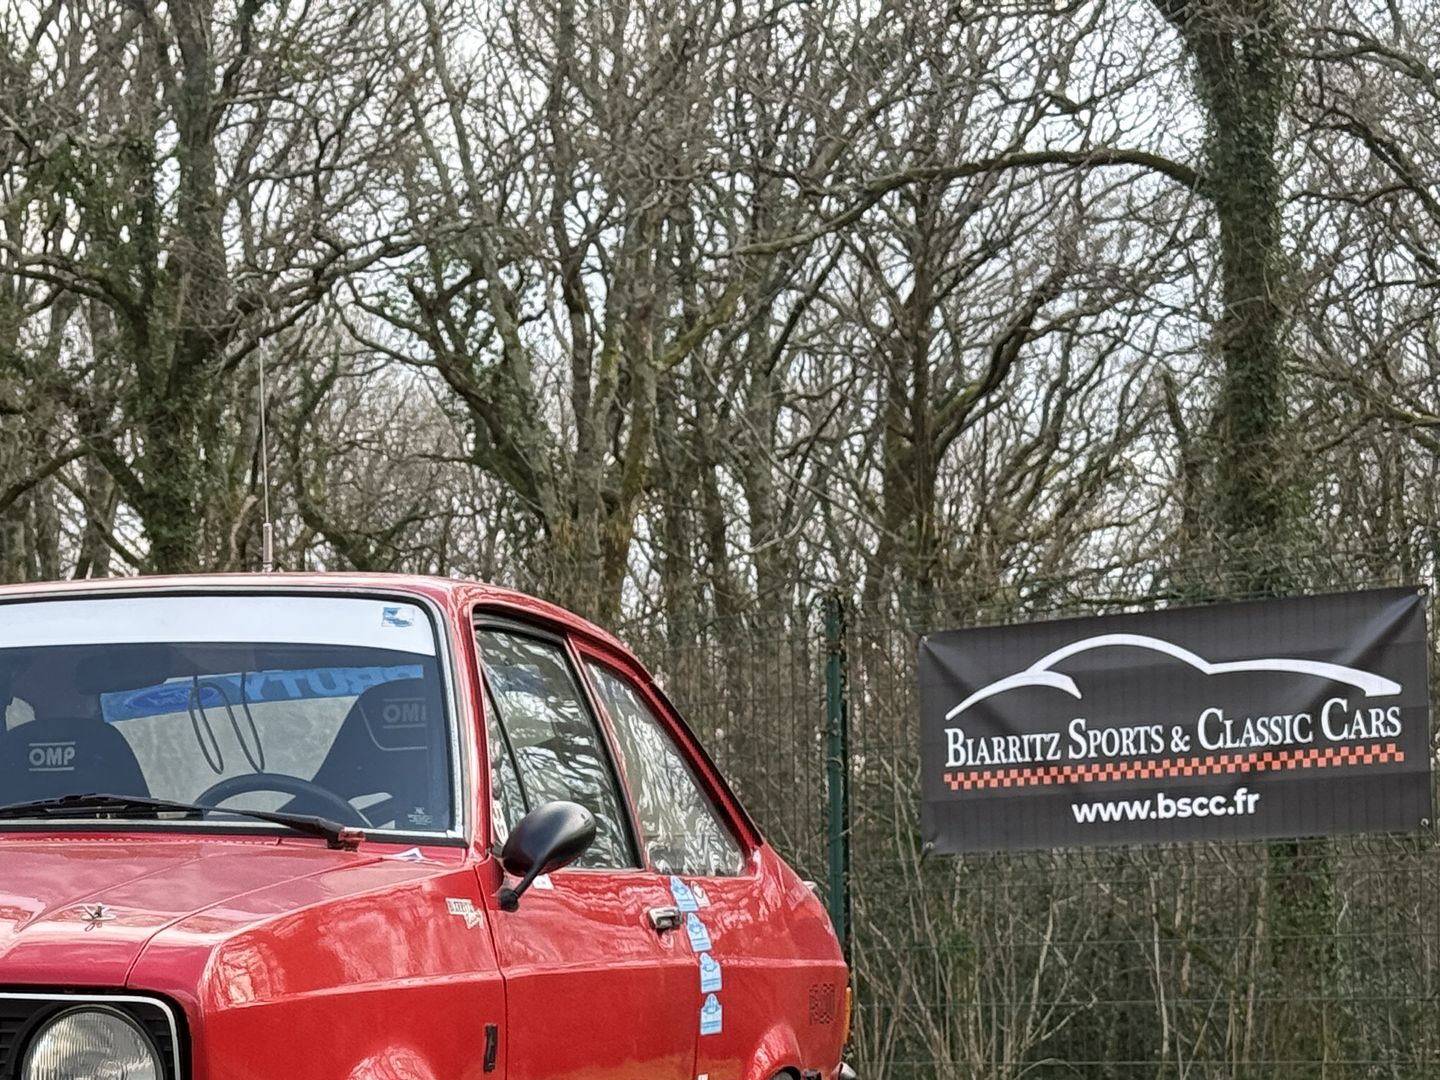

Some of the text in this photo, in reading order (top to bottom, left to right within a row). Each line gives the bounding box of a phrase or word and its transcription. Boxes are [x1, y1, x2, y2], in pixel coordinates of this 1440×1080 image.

[944, 697, 1402, 767] BIARRITZ SPORTS & CLASSIC CARS
[28, 746, 76, 766] OMP
[1071, 787, 1260, 823] www.bscc.fr
